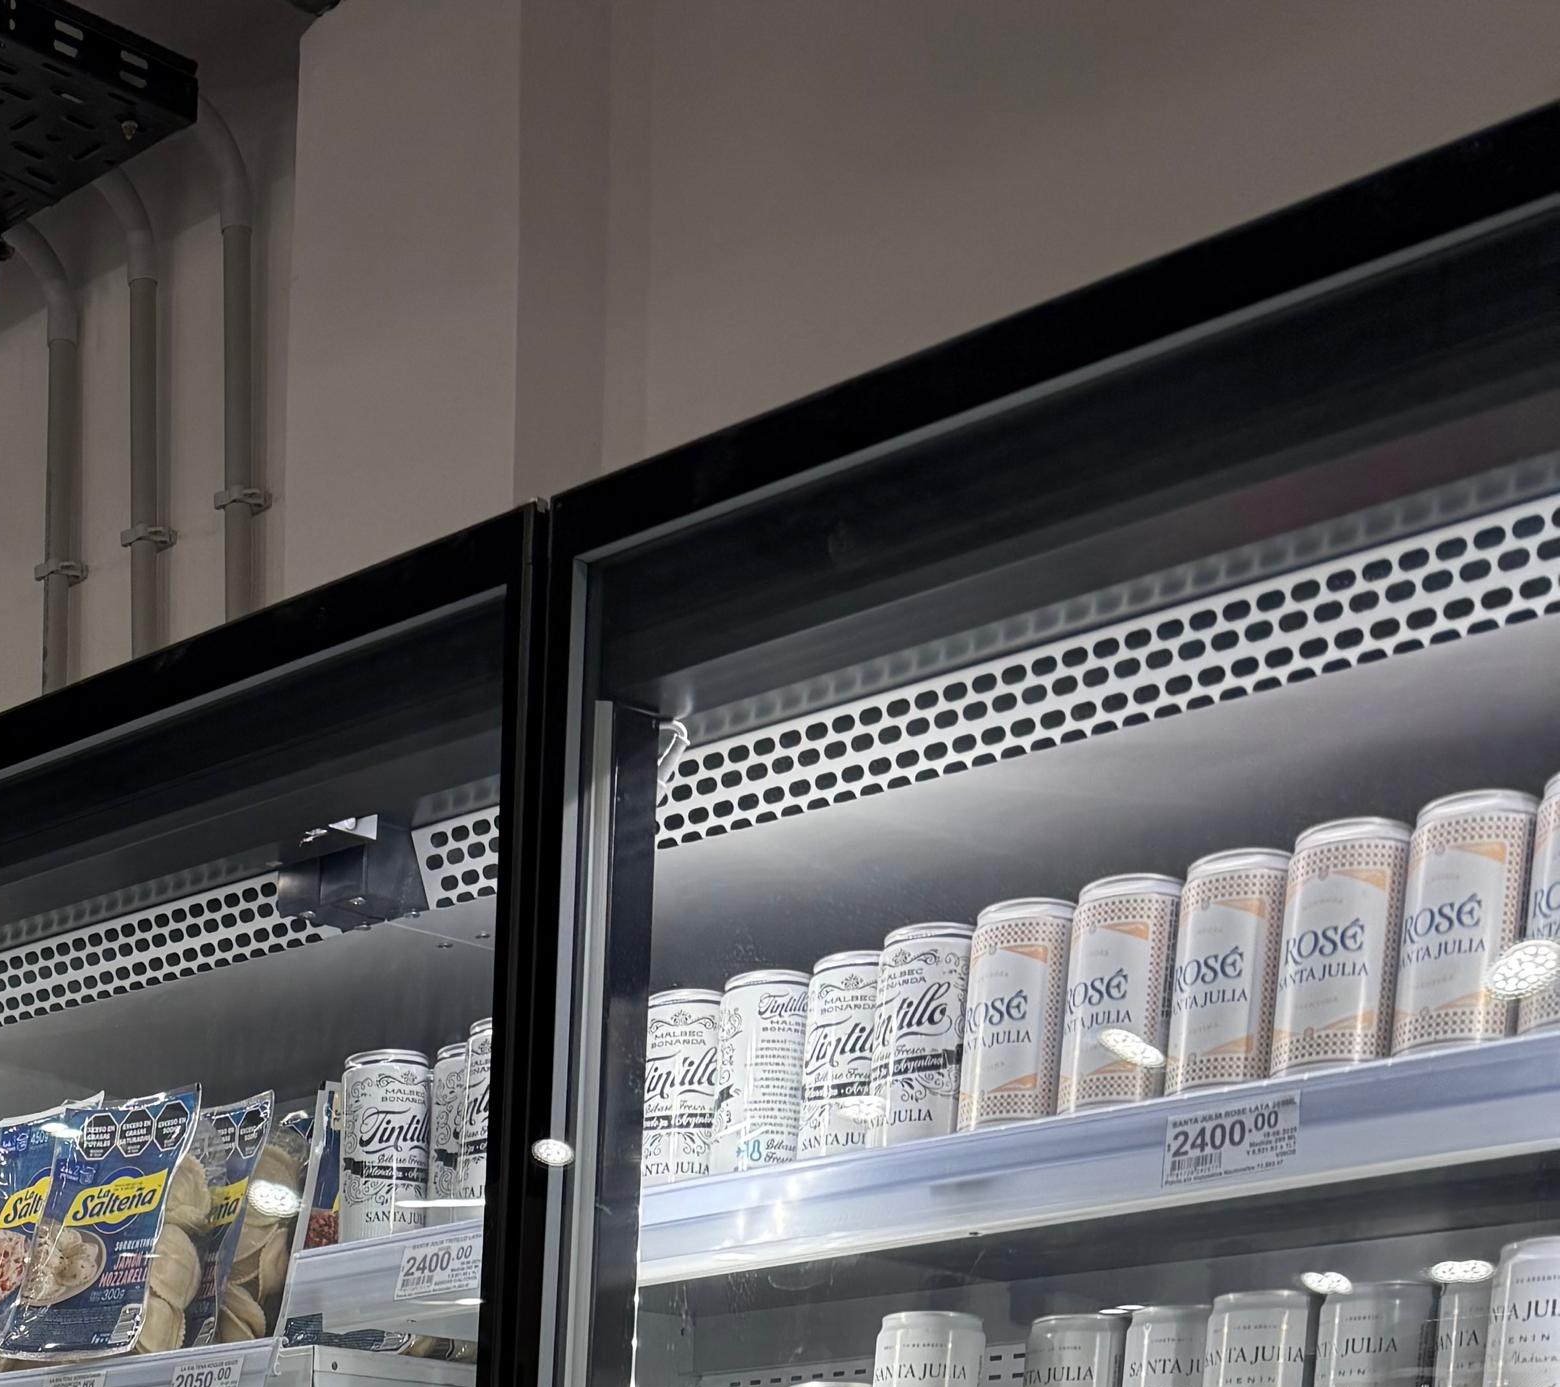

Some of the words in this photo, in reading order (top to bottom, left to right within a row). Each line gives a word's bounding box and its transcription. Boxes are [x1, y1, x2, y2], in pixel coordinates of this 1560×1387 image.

[1403, 893, 1482, 946] ROSÉ
[1284, 918, 1365, 967] ROSÉ
[1174, 946, 1245, 993] ROSÉ
[1319, 962, 1368, 981] JULIA
[1066, 968, 1128, 1016] ROSÉ
[964, 990, 1028, 1034] ROSÉ
[987, 1029, 1032, 1048] JULIA
[122, 1121, 143, 1131] EXCESO
[125, 1128, 147, 1137] GRASAS
[158, 1118, 178, 1128] EXCESO
[97, 1188, 110, 1200] La
[72, 1188, 157, 1221] Salteña
[1341, 1337, 1398, 1357] JULIA
[1043, 1366, 1094, 1383] JULIA
